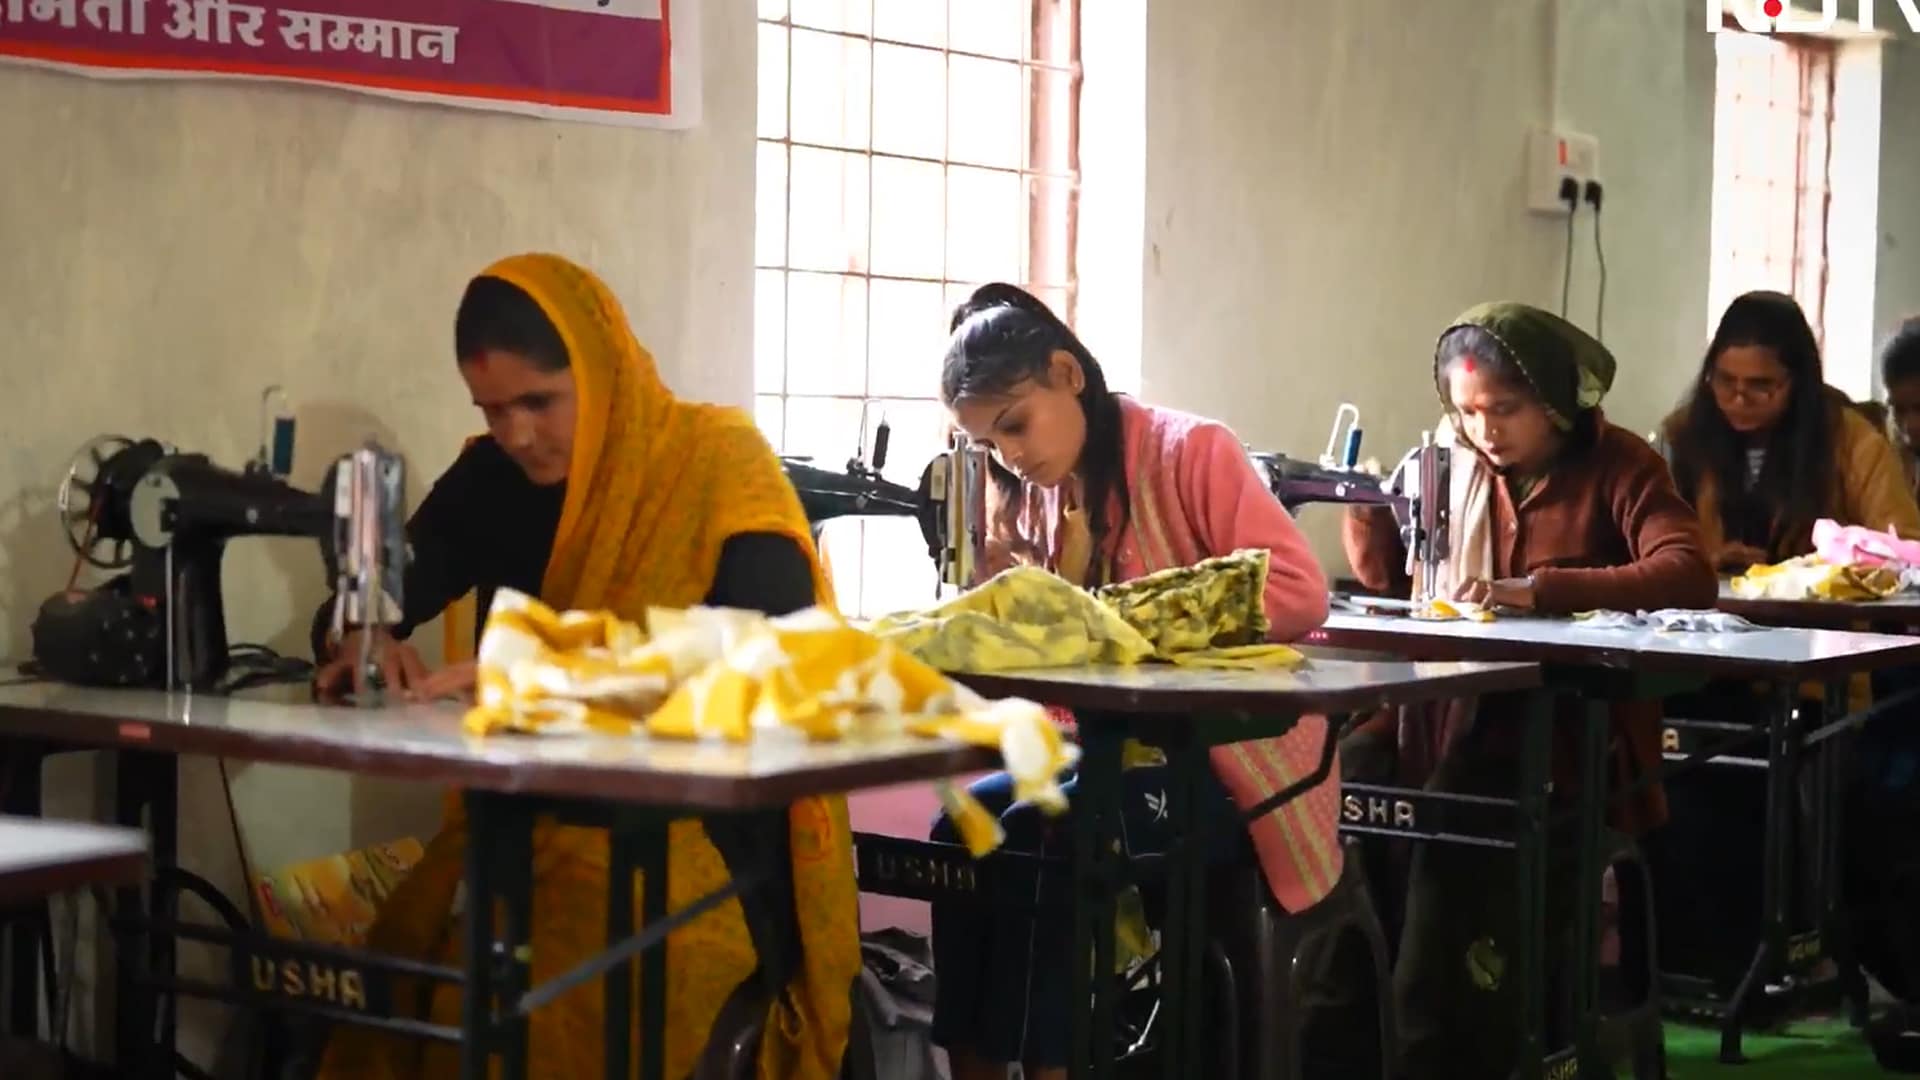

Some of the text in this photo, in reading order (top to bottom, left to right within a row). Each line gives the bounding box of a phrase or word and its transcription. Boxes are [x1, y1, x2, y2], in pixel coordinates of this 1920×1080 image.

[0, 0, 146, 34] मता
[276, 8, 460, 64] सम्मान
[1343, 794, 1416, 828] SHA
[250, 953, 366, 1010] USHA
